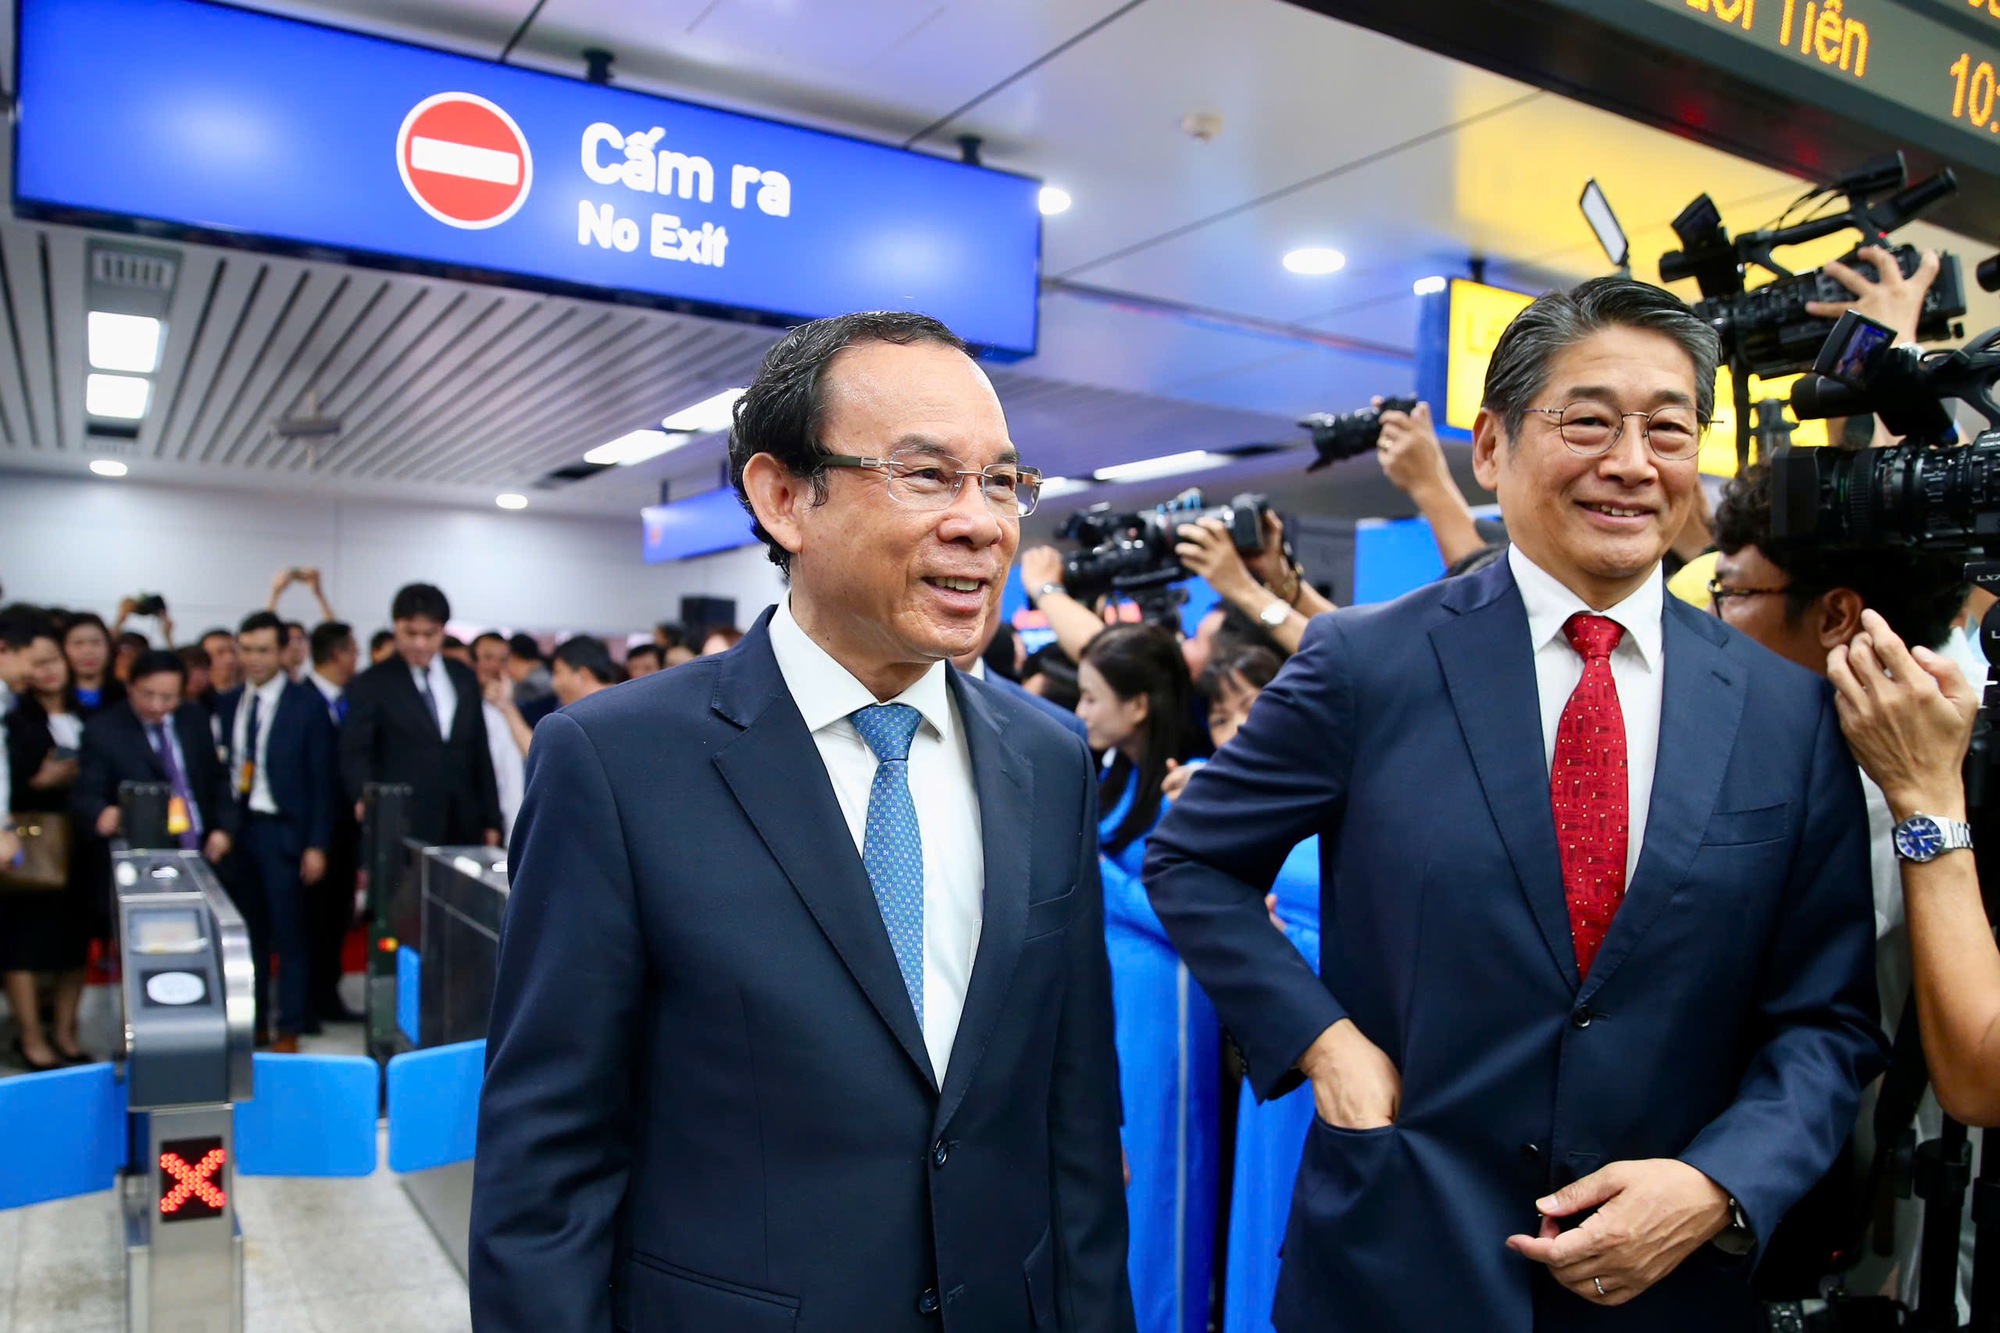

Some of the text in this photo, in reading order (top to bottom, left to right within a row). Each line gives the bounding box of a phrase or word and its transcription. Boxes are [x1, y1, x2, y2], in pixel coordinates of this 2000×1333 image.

[580, 122, 791, 218] Cấm ra
[577, 199, 729, 268] No Exit
